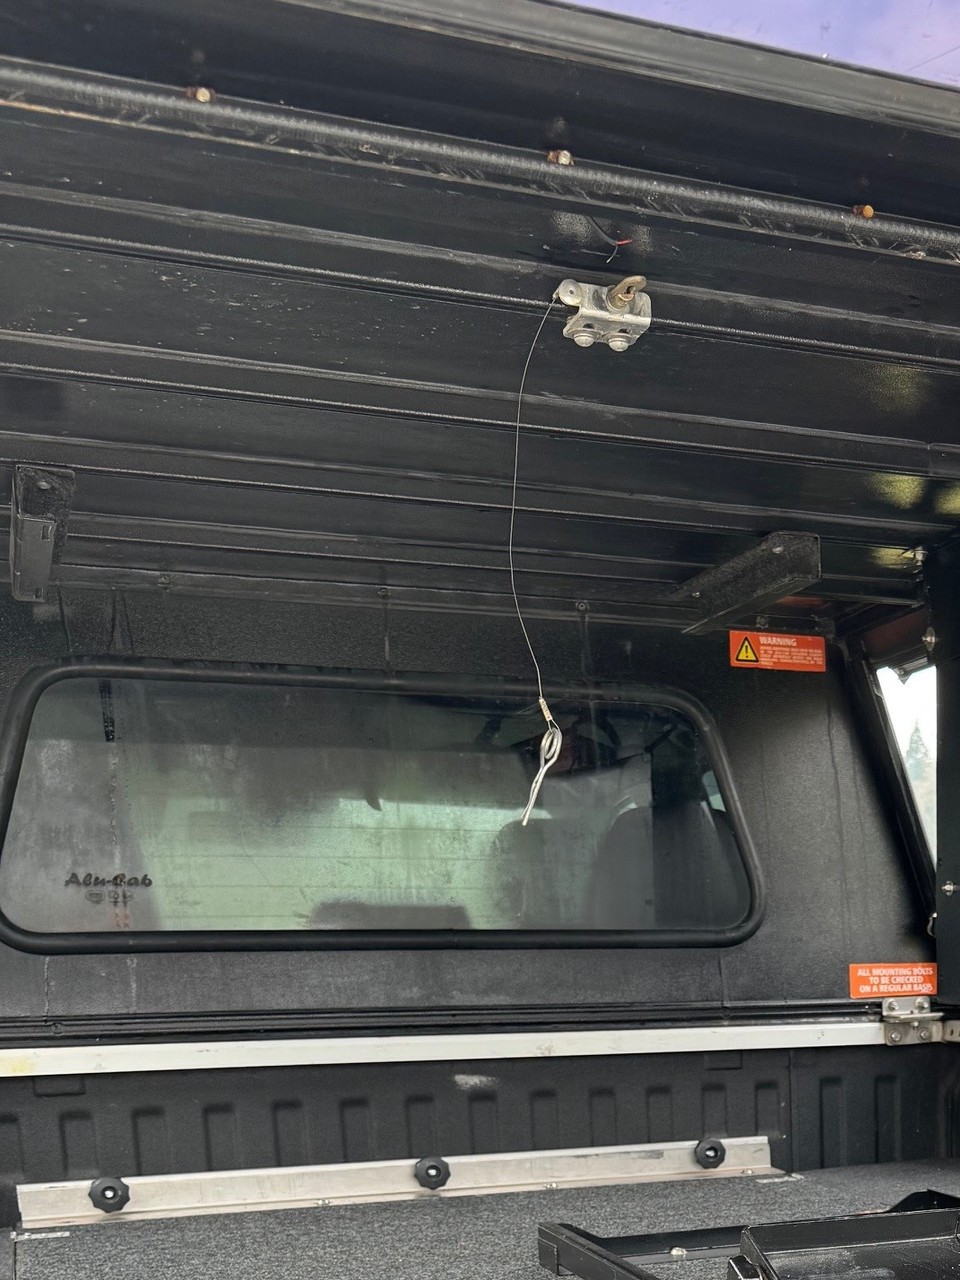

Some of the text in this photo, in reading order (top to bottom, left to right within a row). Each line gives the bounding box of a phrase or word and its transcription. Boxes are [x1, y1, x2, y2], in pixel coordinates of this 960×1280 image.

[759, 636, 797, 647] WARNING
[857, 967, 933, 976] ALL MOUNTING BOLTS
[881, 976, 890, 984] BE
[891, 976, 924, 984] CHECKED
[859, 985, 871, 993] ON
[880, 984, 912, 992] REGULAR
